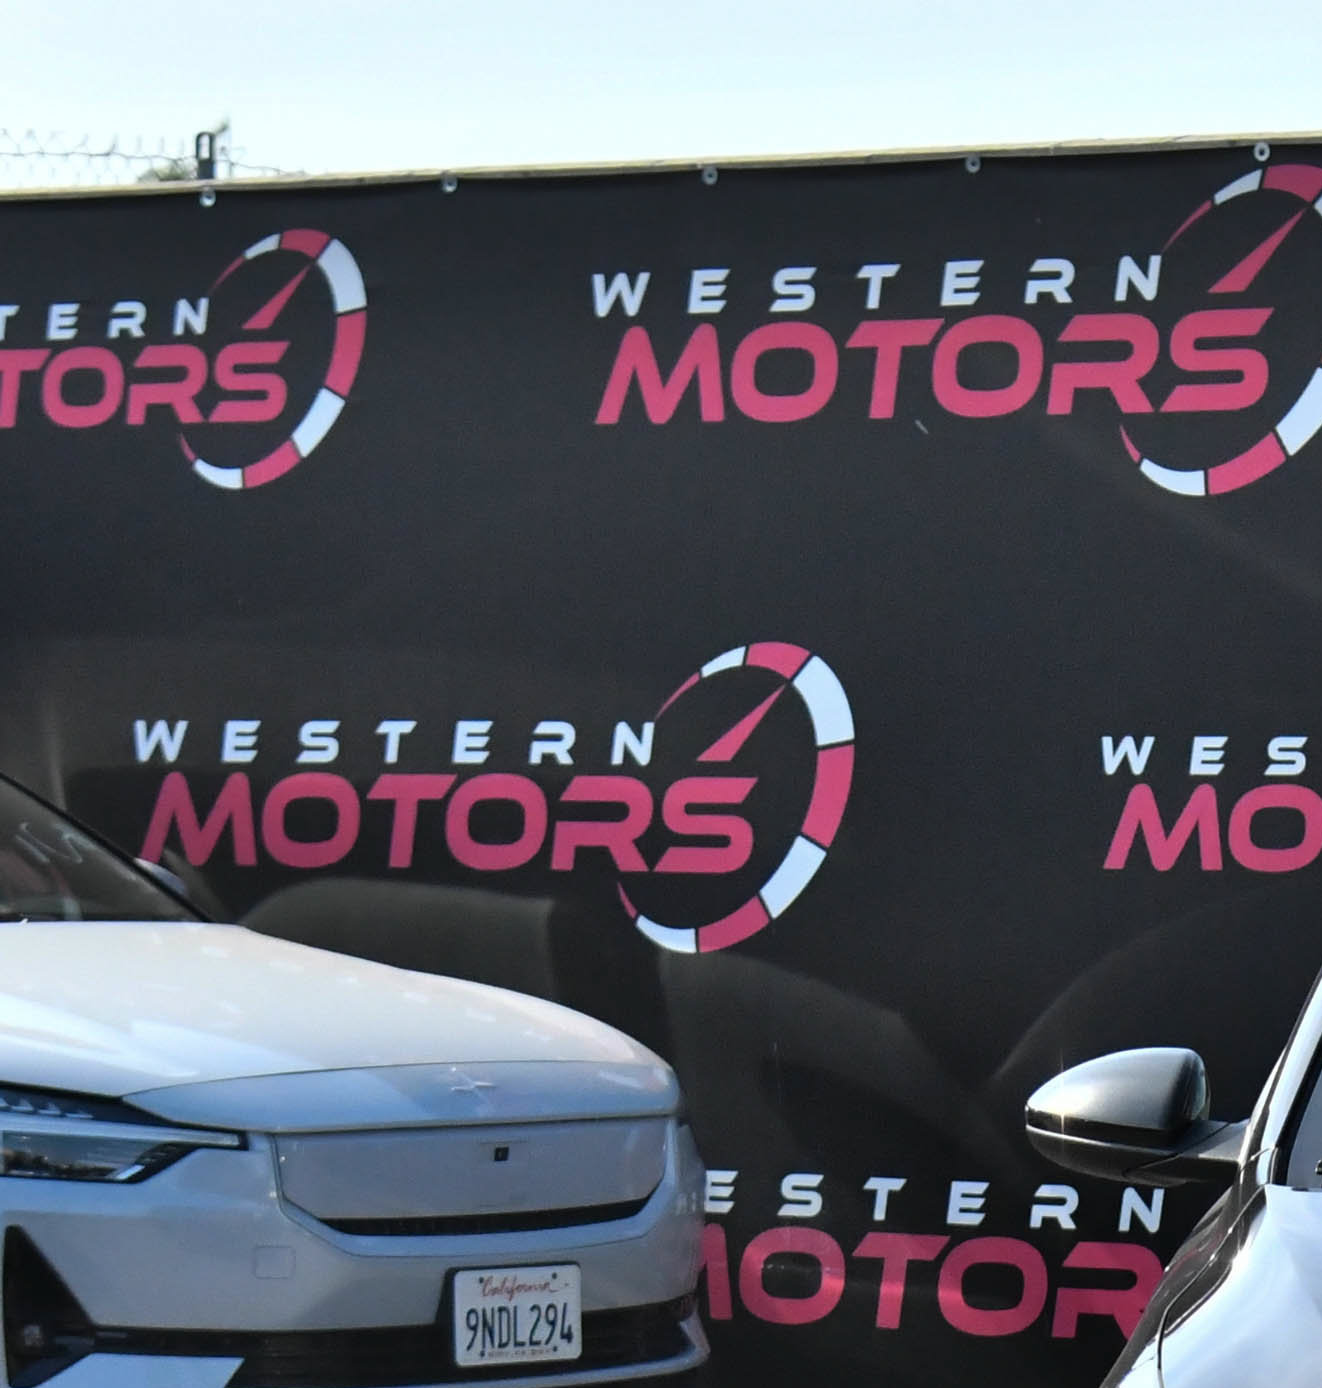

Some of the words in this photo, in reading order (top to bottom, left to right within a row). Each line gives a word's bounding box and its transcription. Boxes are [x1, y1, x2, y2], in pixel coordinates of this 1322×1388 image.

[593, 254, 1162, 317] WESTERN
[0, 341, 290, 429] TORS
[596, 307, 1274, 425] MOTORS
[134, 719, 655, 766] WESTERN
[141, 772, 758, 874] MOTORS
[482, 1274, 560, 1302] California
[465, 1302, 574, 1352] 9NDL294
